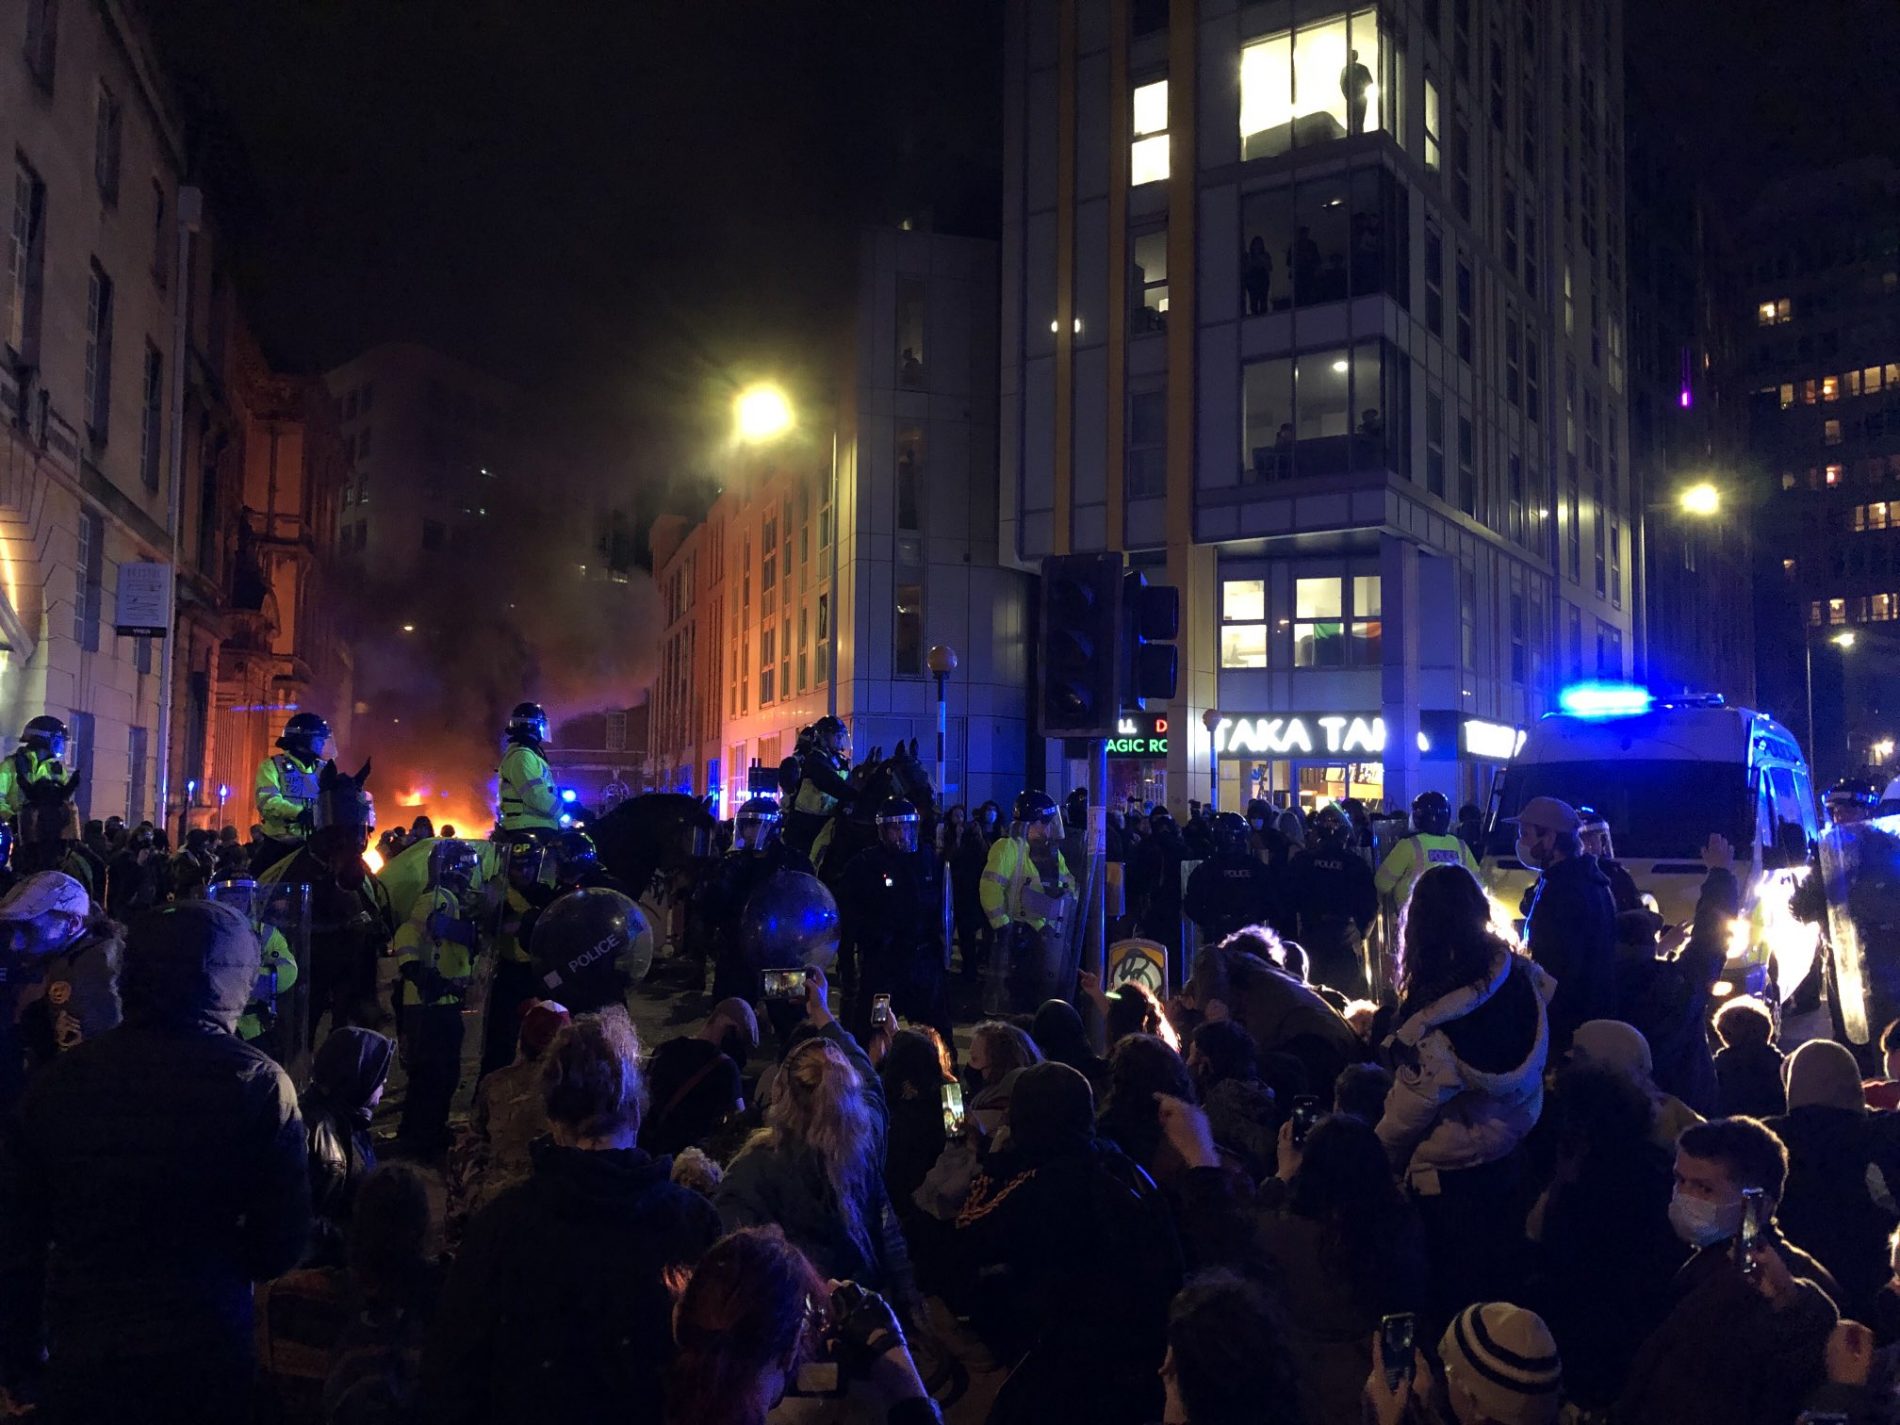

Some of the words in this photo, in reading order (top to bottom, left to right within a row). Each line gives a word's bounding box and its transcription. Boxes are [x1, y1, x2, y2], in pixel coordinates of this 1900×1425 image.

[1118, 719, 1138, 734] LL
[1156, 719, 1168, 733] D
[1212, 717, 1313, 752] TAKA
[1105, 739, 1145, 753] AGIC
[1149, 739, 1168, 753] RO
[1314, 858, 1344, 871] POLICE
[1224, 868, 1252, 879] POLICE
[567, 933, 621, 973] POLICE
